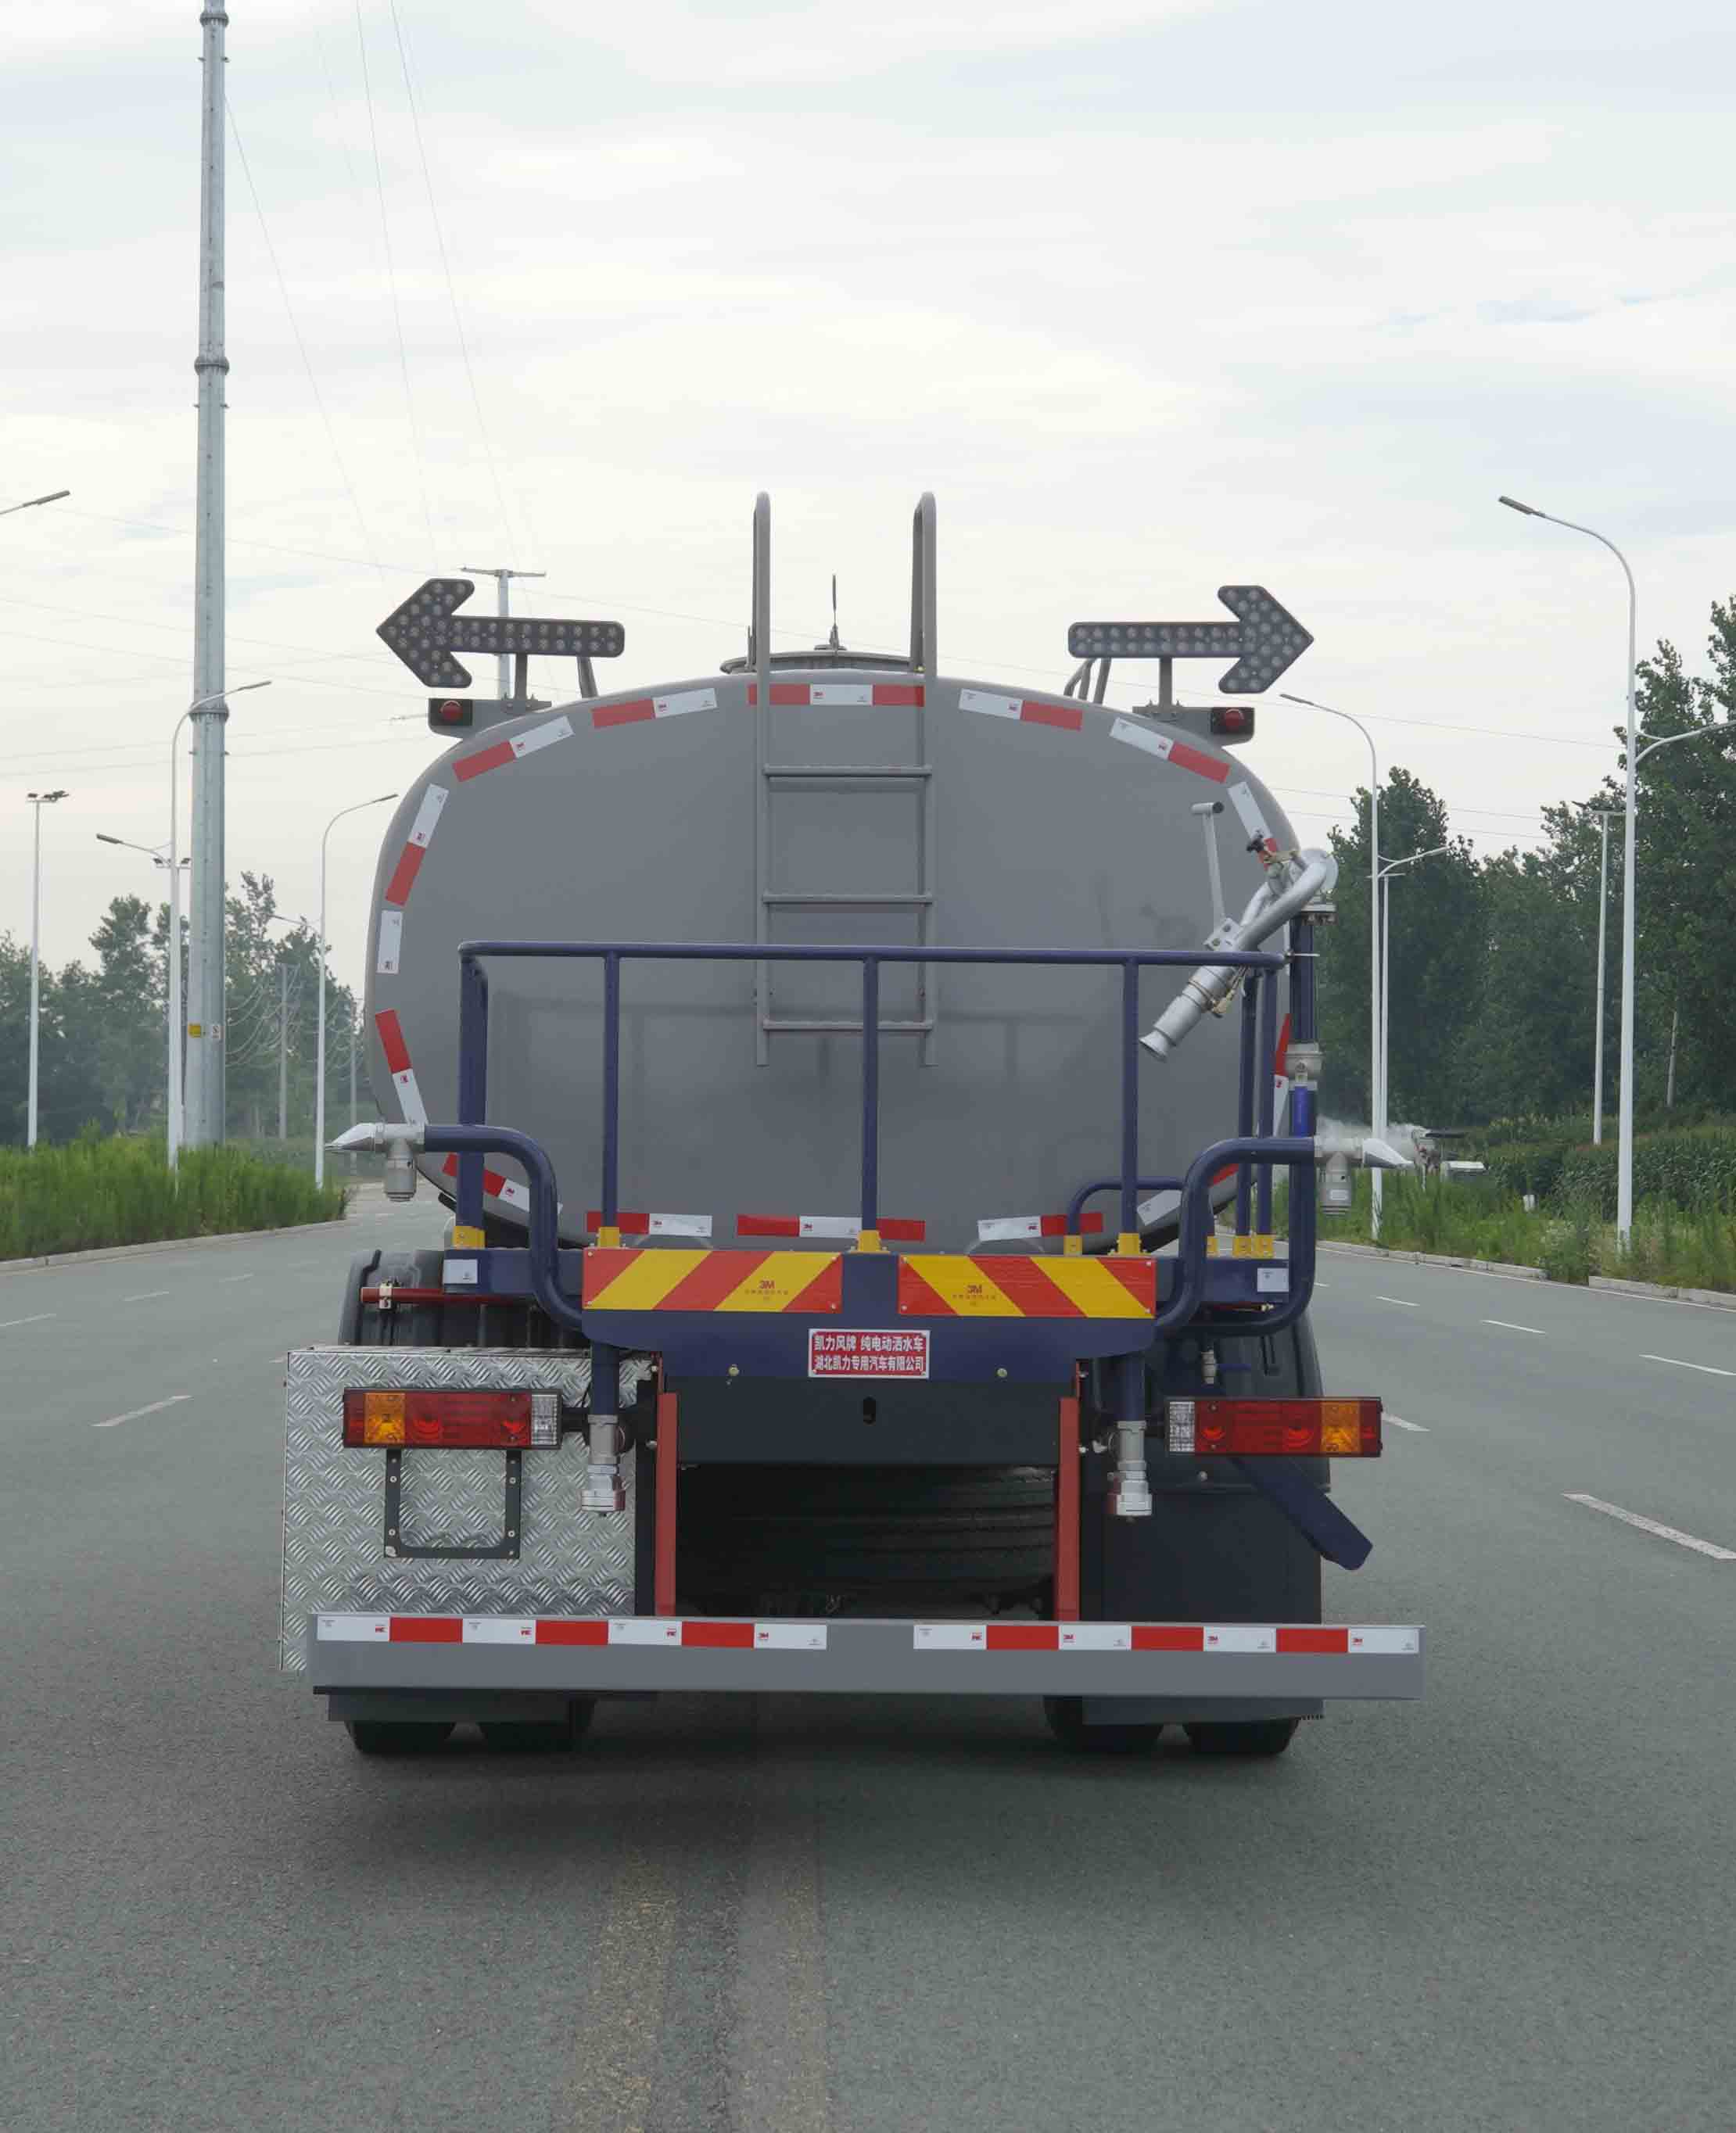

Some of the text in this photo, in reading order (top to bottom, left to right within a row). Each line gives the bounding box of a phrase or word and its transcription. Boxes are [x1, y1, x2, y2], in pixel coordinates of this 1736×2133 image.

[860, 1335, 924, 1352] 纯电动洒水车
